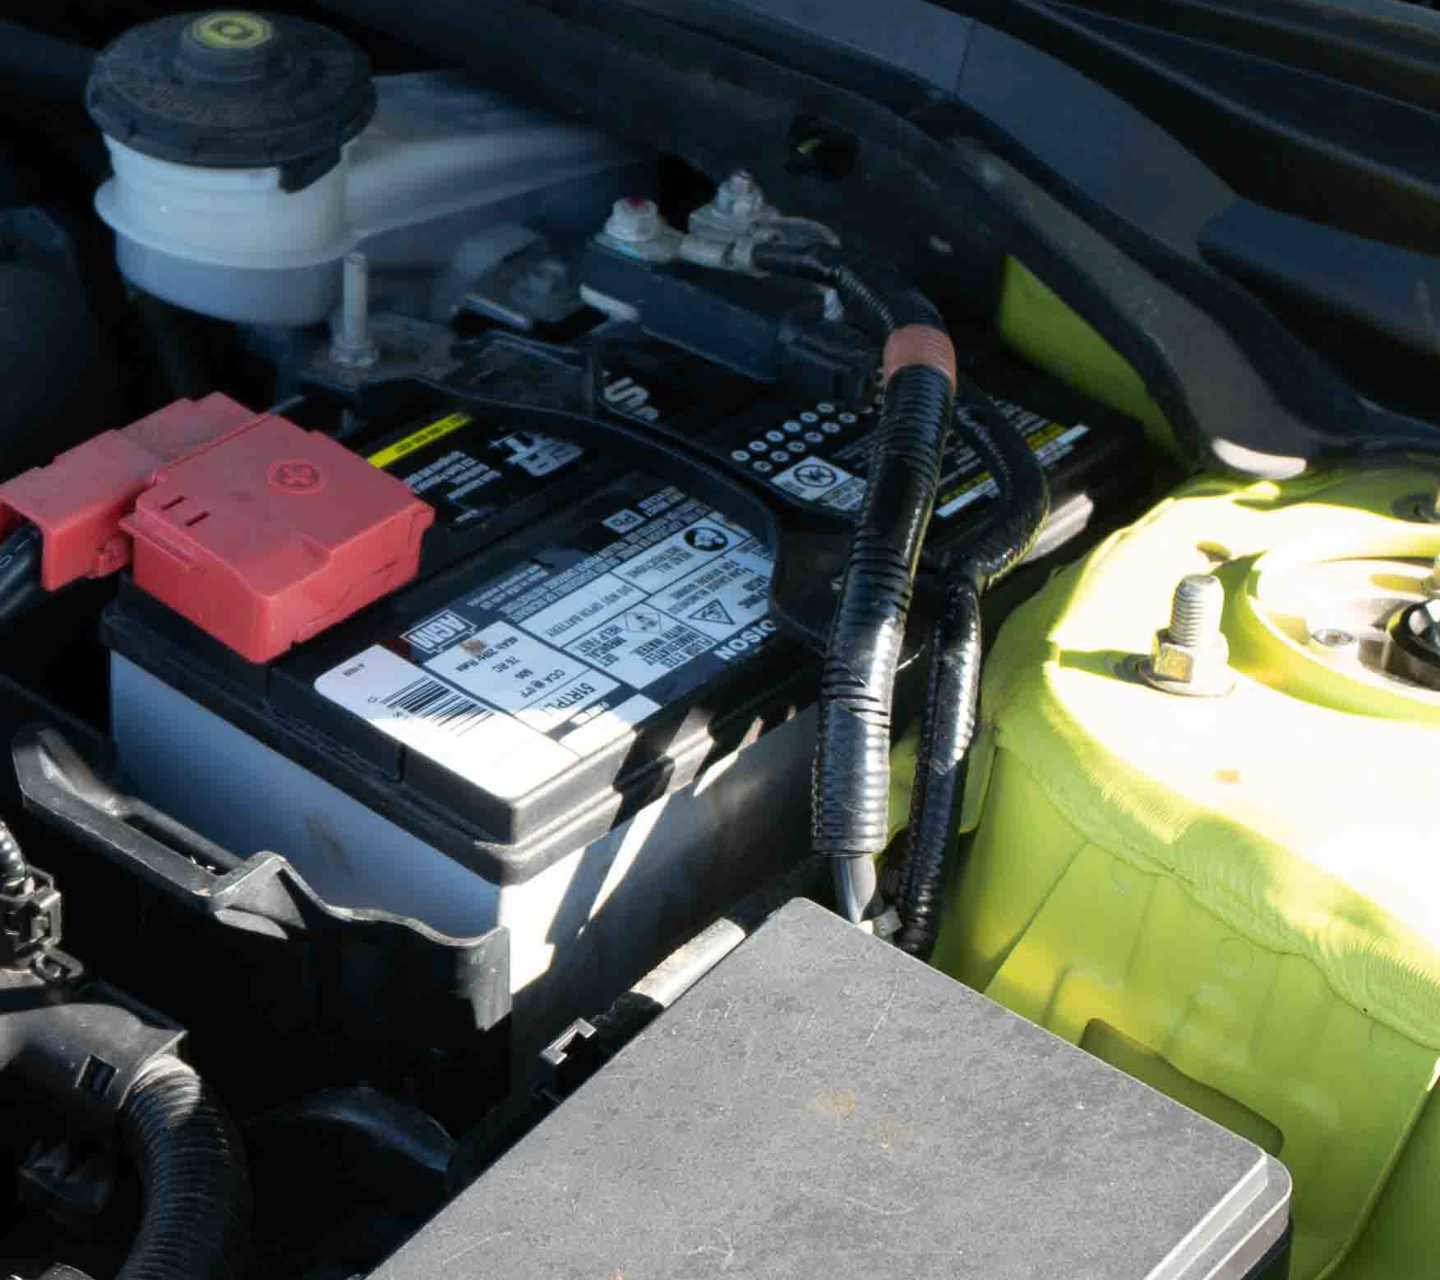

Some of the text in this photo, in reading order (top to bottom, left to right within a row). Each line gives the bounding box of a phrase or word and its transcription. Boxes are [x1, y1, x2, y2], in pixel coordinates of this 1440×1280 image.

[408, 614, 467, 648] AGM
[715, 619, 777, 661] OISON
[542, 668, 566, 683] CCA
